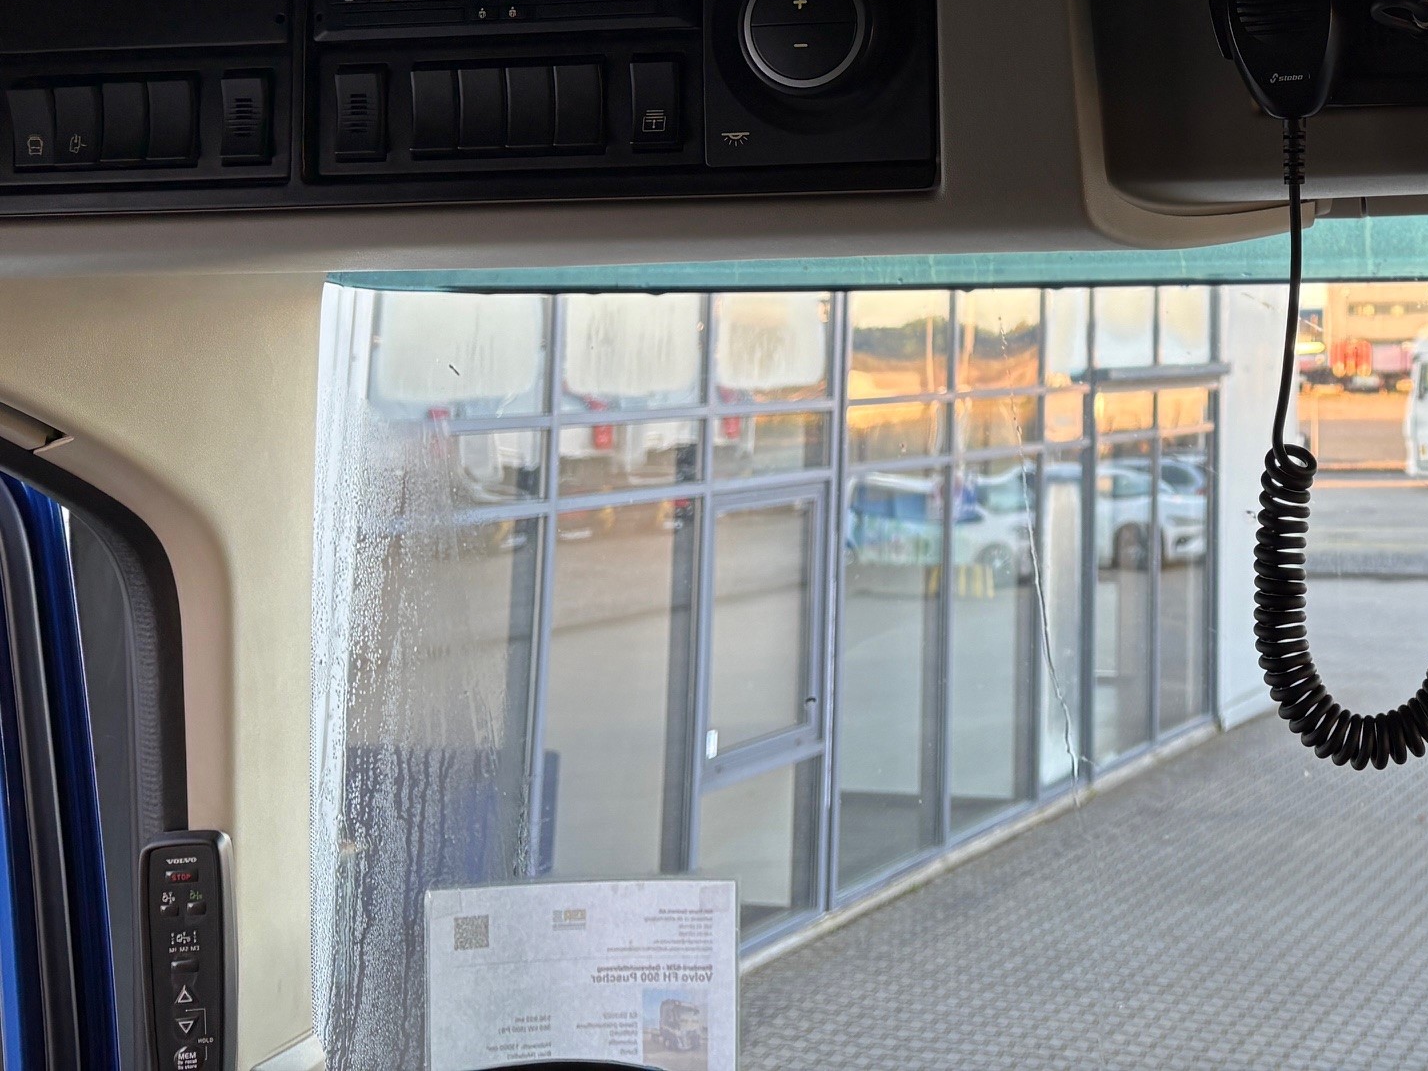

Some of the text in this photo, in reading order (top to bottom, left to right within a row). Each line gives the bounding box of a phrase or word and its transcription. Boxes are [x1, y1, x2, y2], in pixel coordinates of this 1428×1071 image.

[1278, 73, 1304, 82] stabo
[165, 856, 198, 865] VOLVO
[171, 873, 192, 881] STOP
[198, 1036, 214, 1044] HOLD
[178, 1051, 197, 1060] MEM
